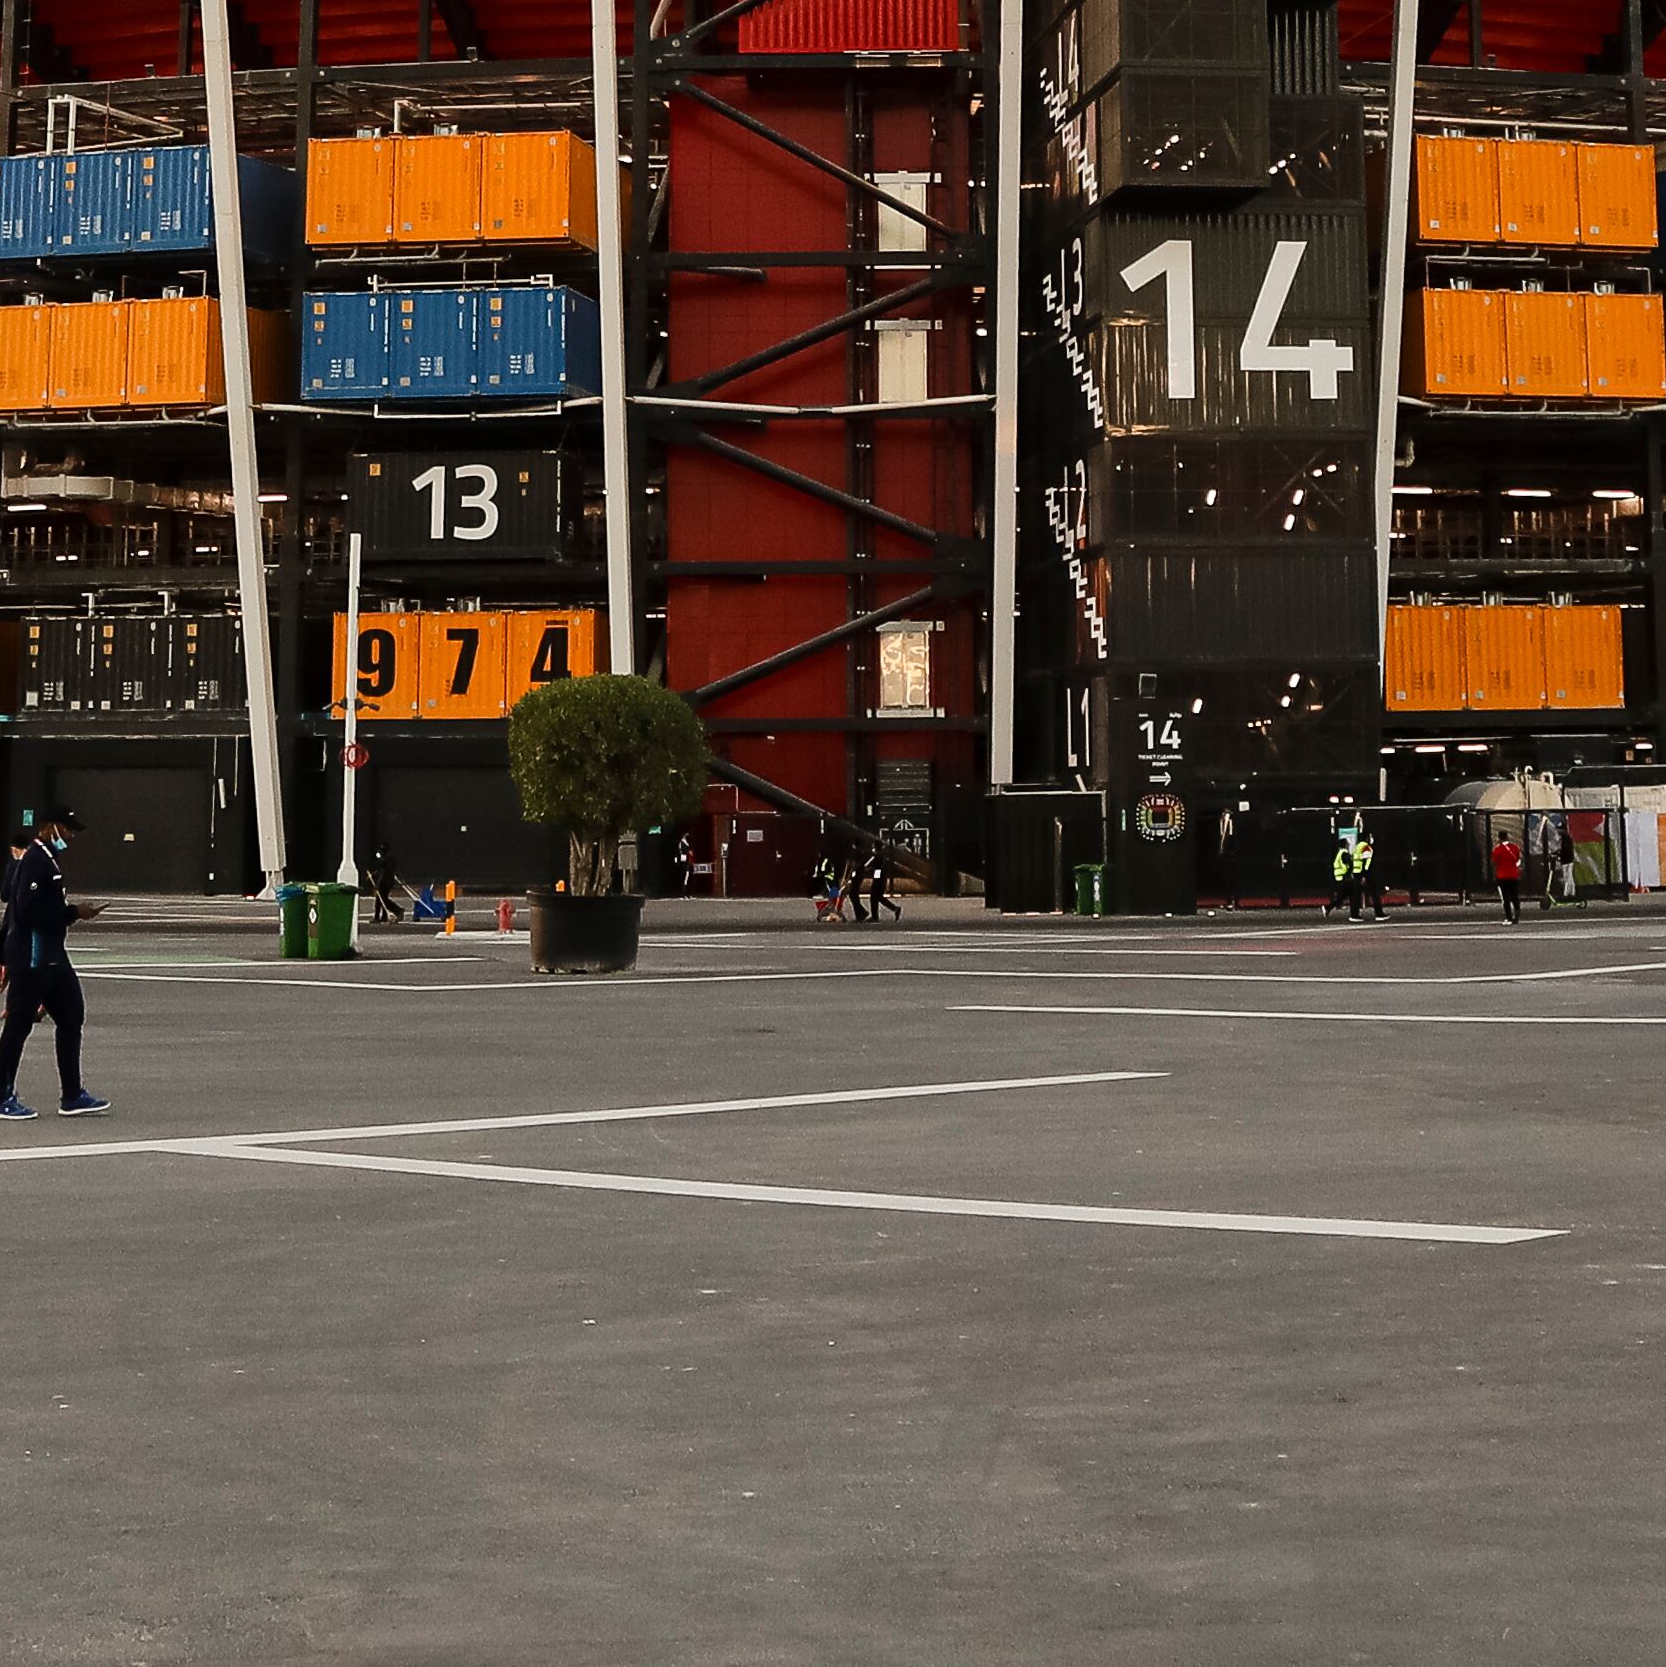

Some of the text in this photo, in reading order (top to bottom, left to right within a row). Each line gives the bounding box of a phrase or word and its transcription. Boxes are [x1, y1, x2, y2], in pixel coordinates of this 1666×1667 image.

[1120, 239, 1354, 400] 14
[411, 463, 500, 541] 13
[1138, 719, 1182, 750] 14
